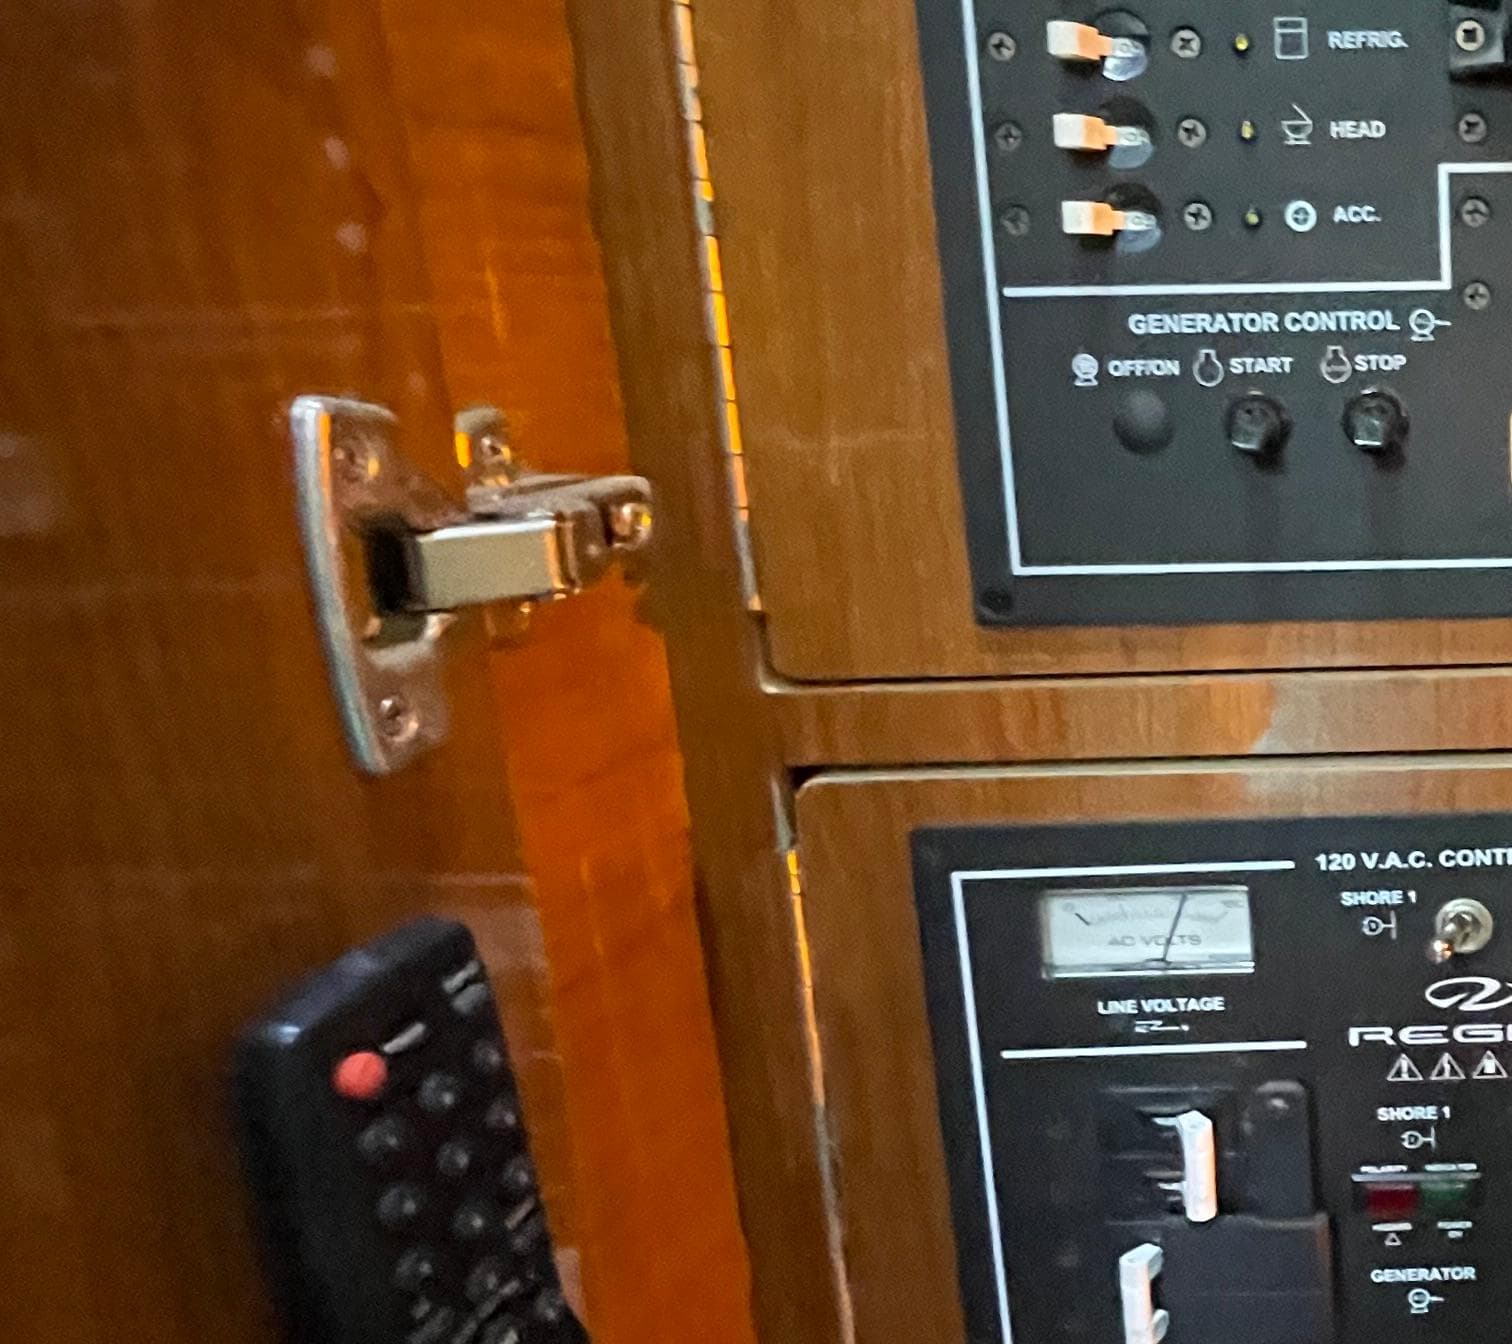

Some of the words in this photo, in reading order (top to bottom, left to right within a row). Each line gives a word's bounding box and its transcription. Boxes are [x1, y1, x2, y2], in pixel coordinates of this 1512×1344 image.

[1330, 120, 1386, 138] HEAD
[1128, 312, 1280, 334] GENERATOR
[1284, 311, 1400, 332] CONTROL
[1229, 356, 1294, 374] START
[1354, 354, 1407, 372] STOP
[1315, 854, 1355, 871] 120
[1361, 851, 1432, 869] V.A.C.
[1340, 891, 1403, 906] SHORE
[1408, 890, 1417, 904] 1
[1098, 999, 1138, 1014] LINE
[1141, 996, 1226, 1013] VOLTAGE
[1377, 1107, 1438, 1122] SHORE
[1442, 1106, 1451, 1120] 1
[1370, 1267, 1476, 1283] GENERATOR
